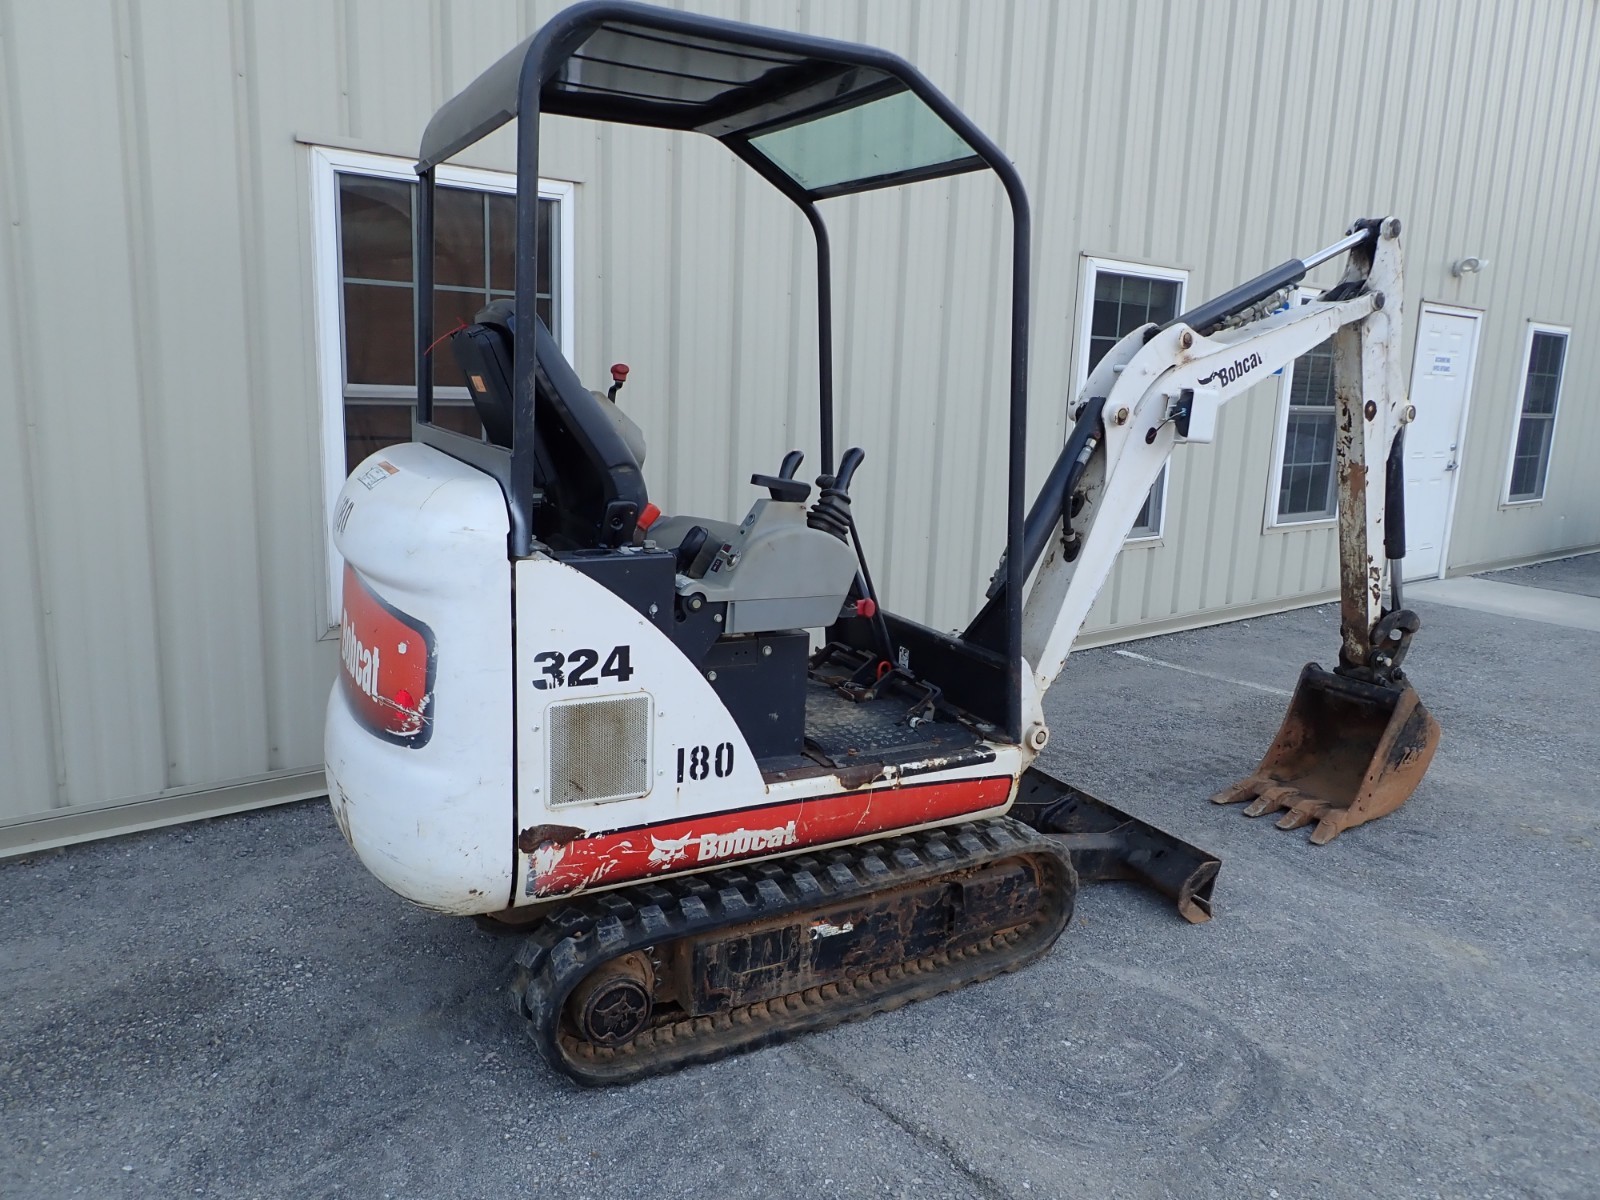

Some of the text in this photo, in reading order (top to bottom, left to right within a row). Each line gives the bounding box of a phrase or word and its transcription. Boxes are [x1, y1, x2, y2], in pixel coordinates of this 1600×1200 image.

[342, 608, 379, 703] Bobcat
[532, 645, 634, 690] 324
[677, 742, 734, 783] 180
[698, 821, 796, 861] Bobcat
